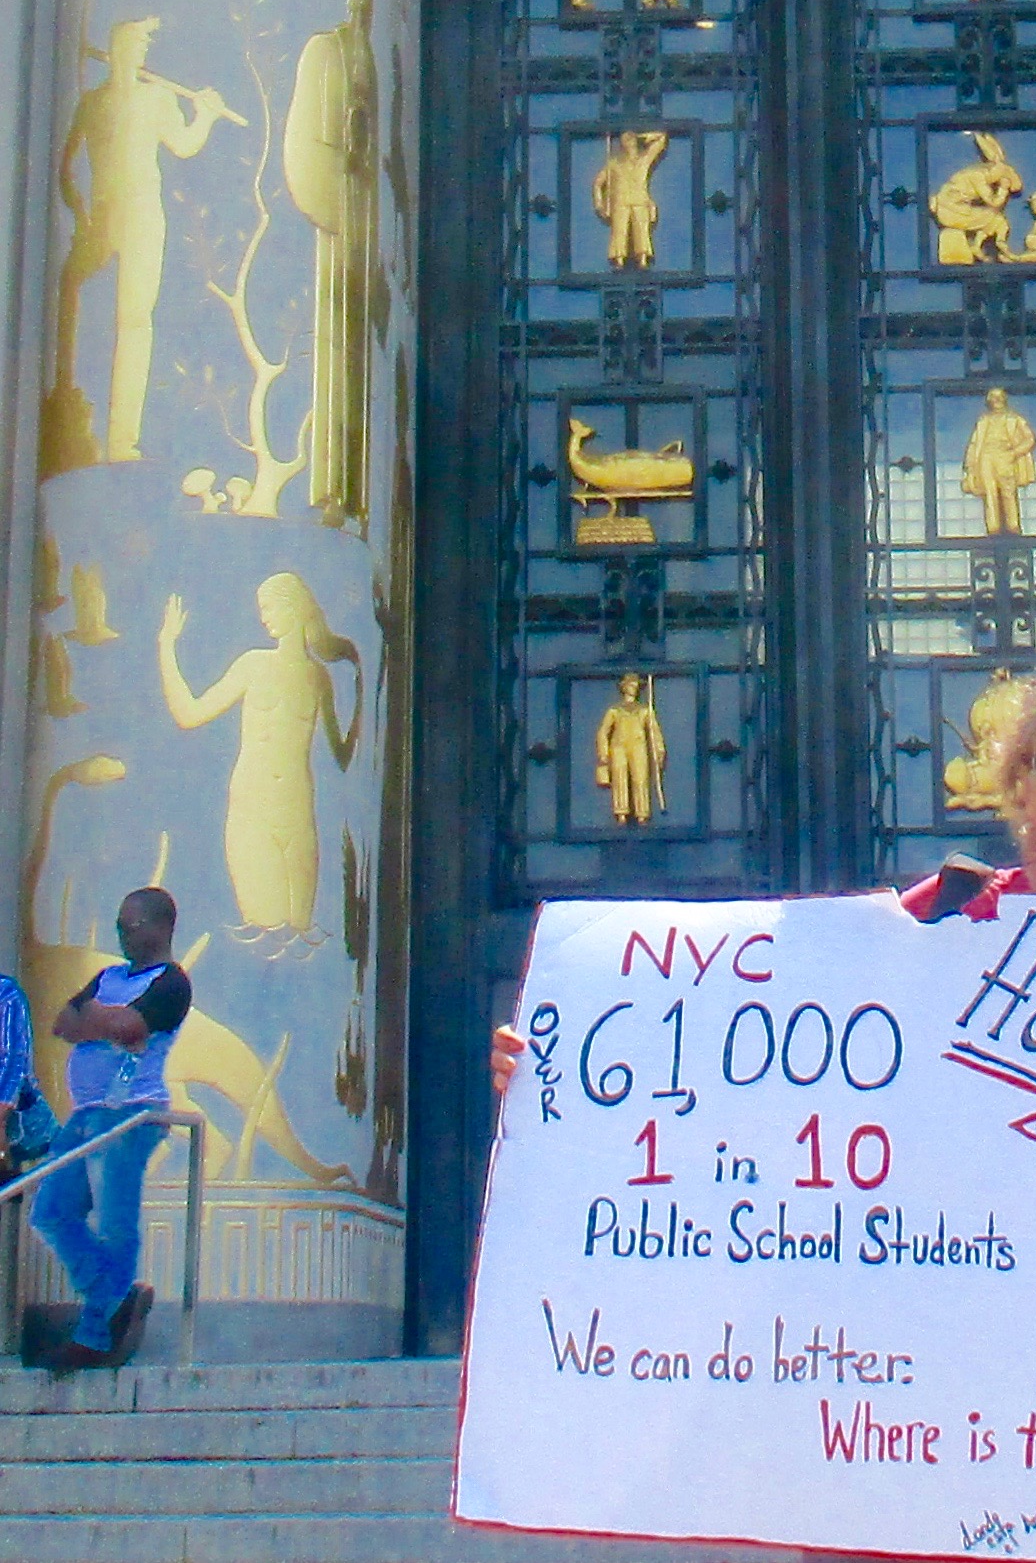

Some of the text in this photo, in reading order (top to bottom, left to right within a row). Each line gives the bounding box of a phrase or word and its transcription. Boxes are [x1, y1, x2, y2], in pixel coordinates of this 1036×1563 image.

[620, 926, 775, 987] NYC
[527, 1001, 562, 1123] OVER
[579, 998, 903, 1117] 61,000
[626, 1113, 892, 1191] 1 in 10
[583, 1195, 1017, 1271] Public School Students
[541, 1298, 616, 1376] We
[630, 1347, 691, 1382] can
[707, 1320, 754, 1383] do
[819, 1399, 941, 1464] Where
[967, 1411, 997, 1463] is
